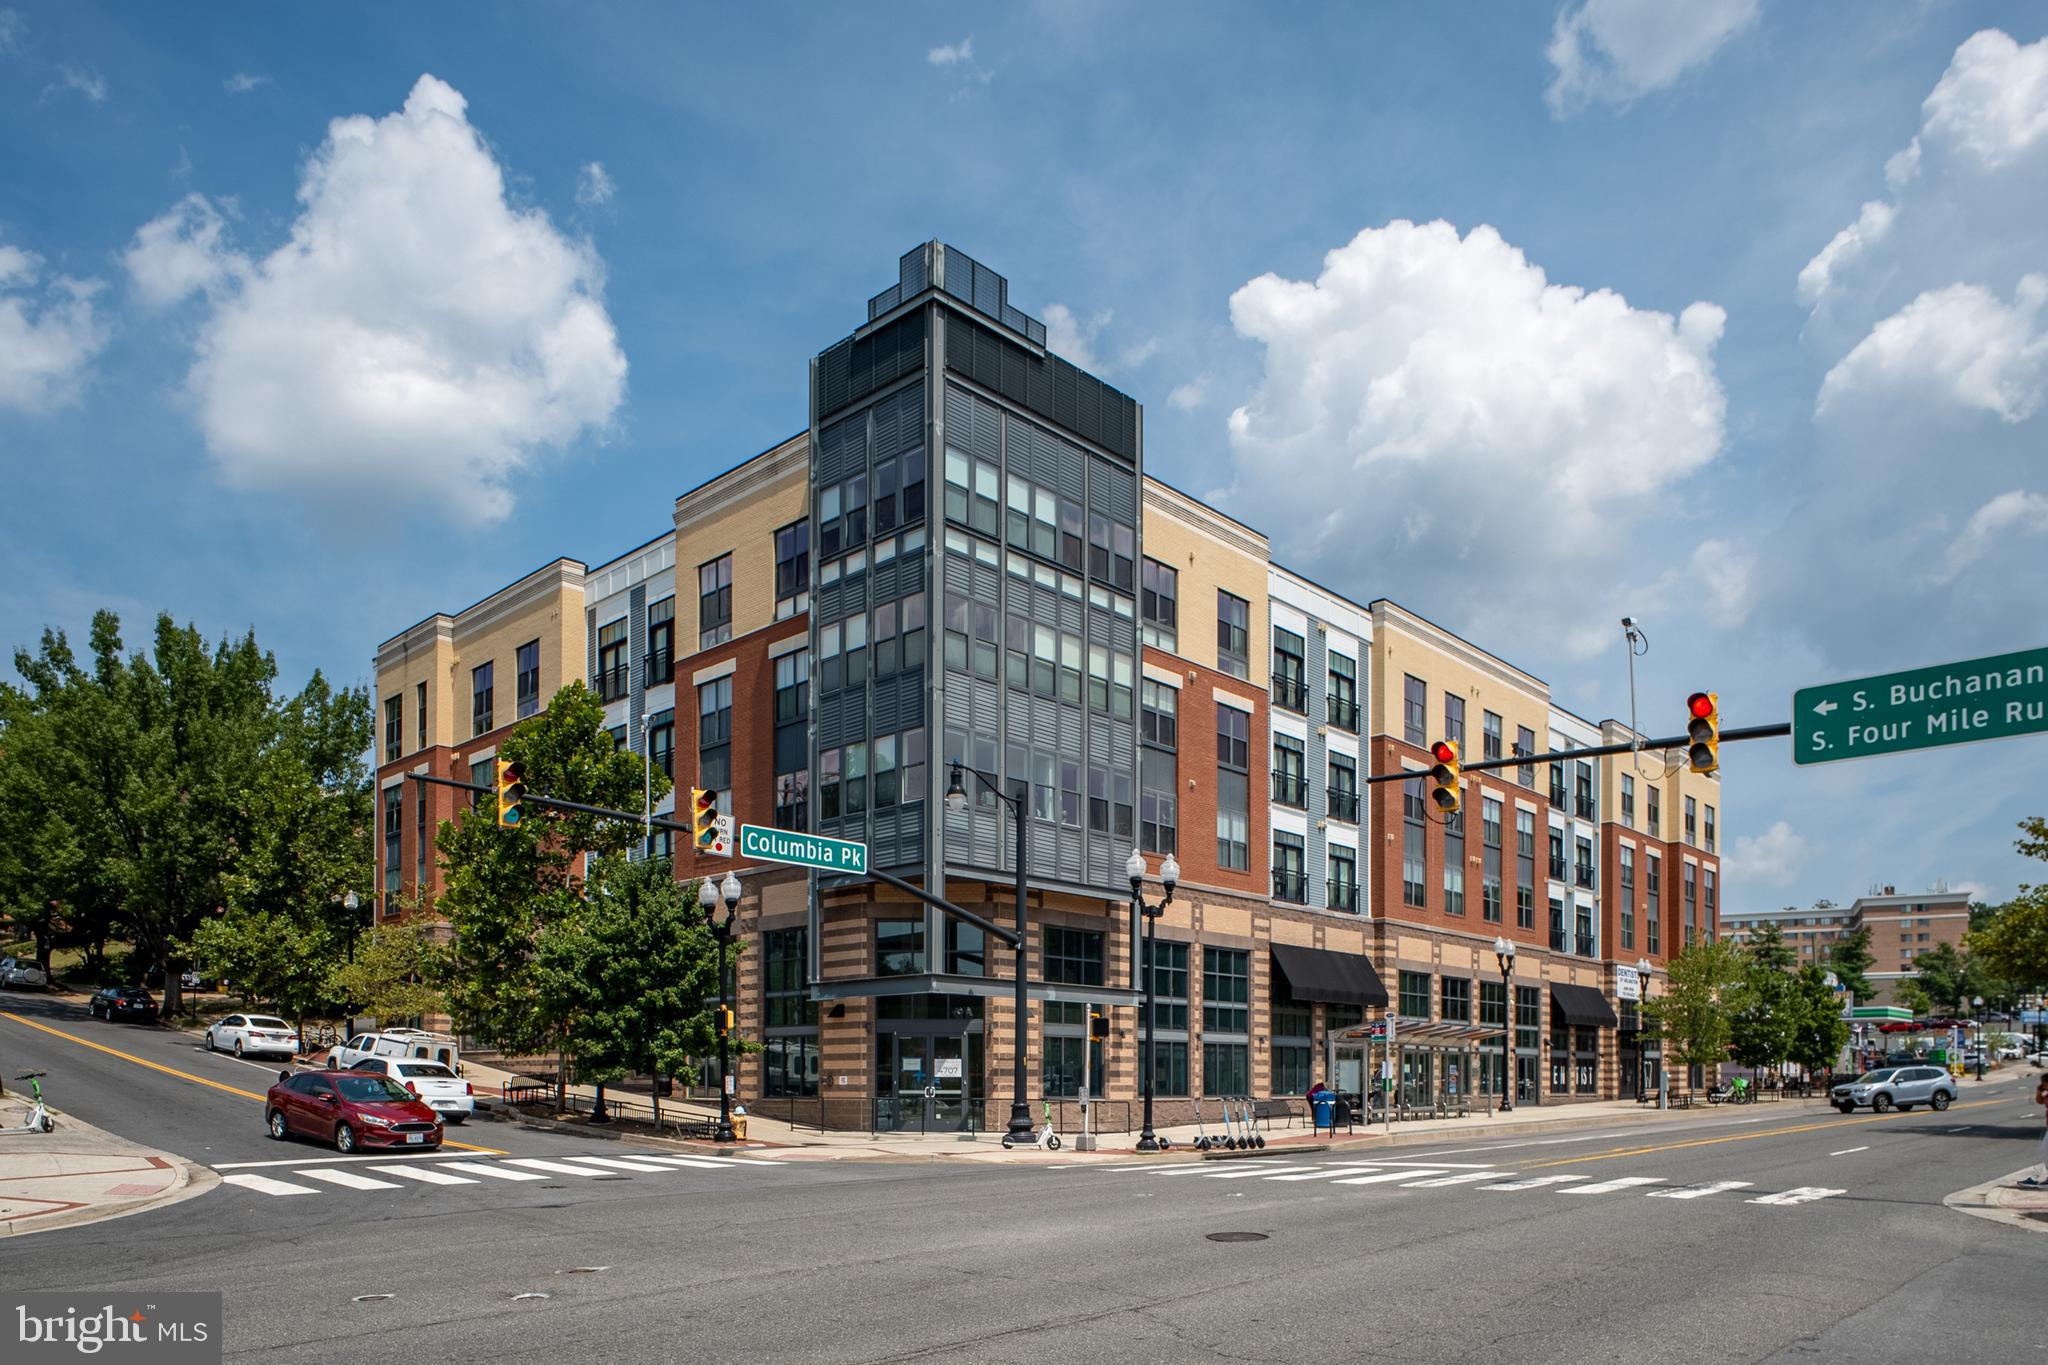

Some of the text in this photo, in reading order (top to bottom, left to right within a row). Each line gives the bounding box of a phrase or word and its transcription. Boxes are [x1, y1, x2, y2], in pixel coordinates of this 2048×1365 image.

[1853, 665, 2044, 711] S. Buchanan
[1811, 731, 1834, 751] S.
[1848, 720, 1912, 746] Four
[1926, 708, 1990, 735] Mile
[714, 818, 727, 827] NO
[719, 836, 731, 844] RED
[747, 832, 861, 867] Columbia Pk
[1618, 968, 1637, 978] DENTIST
